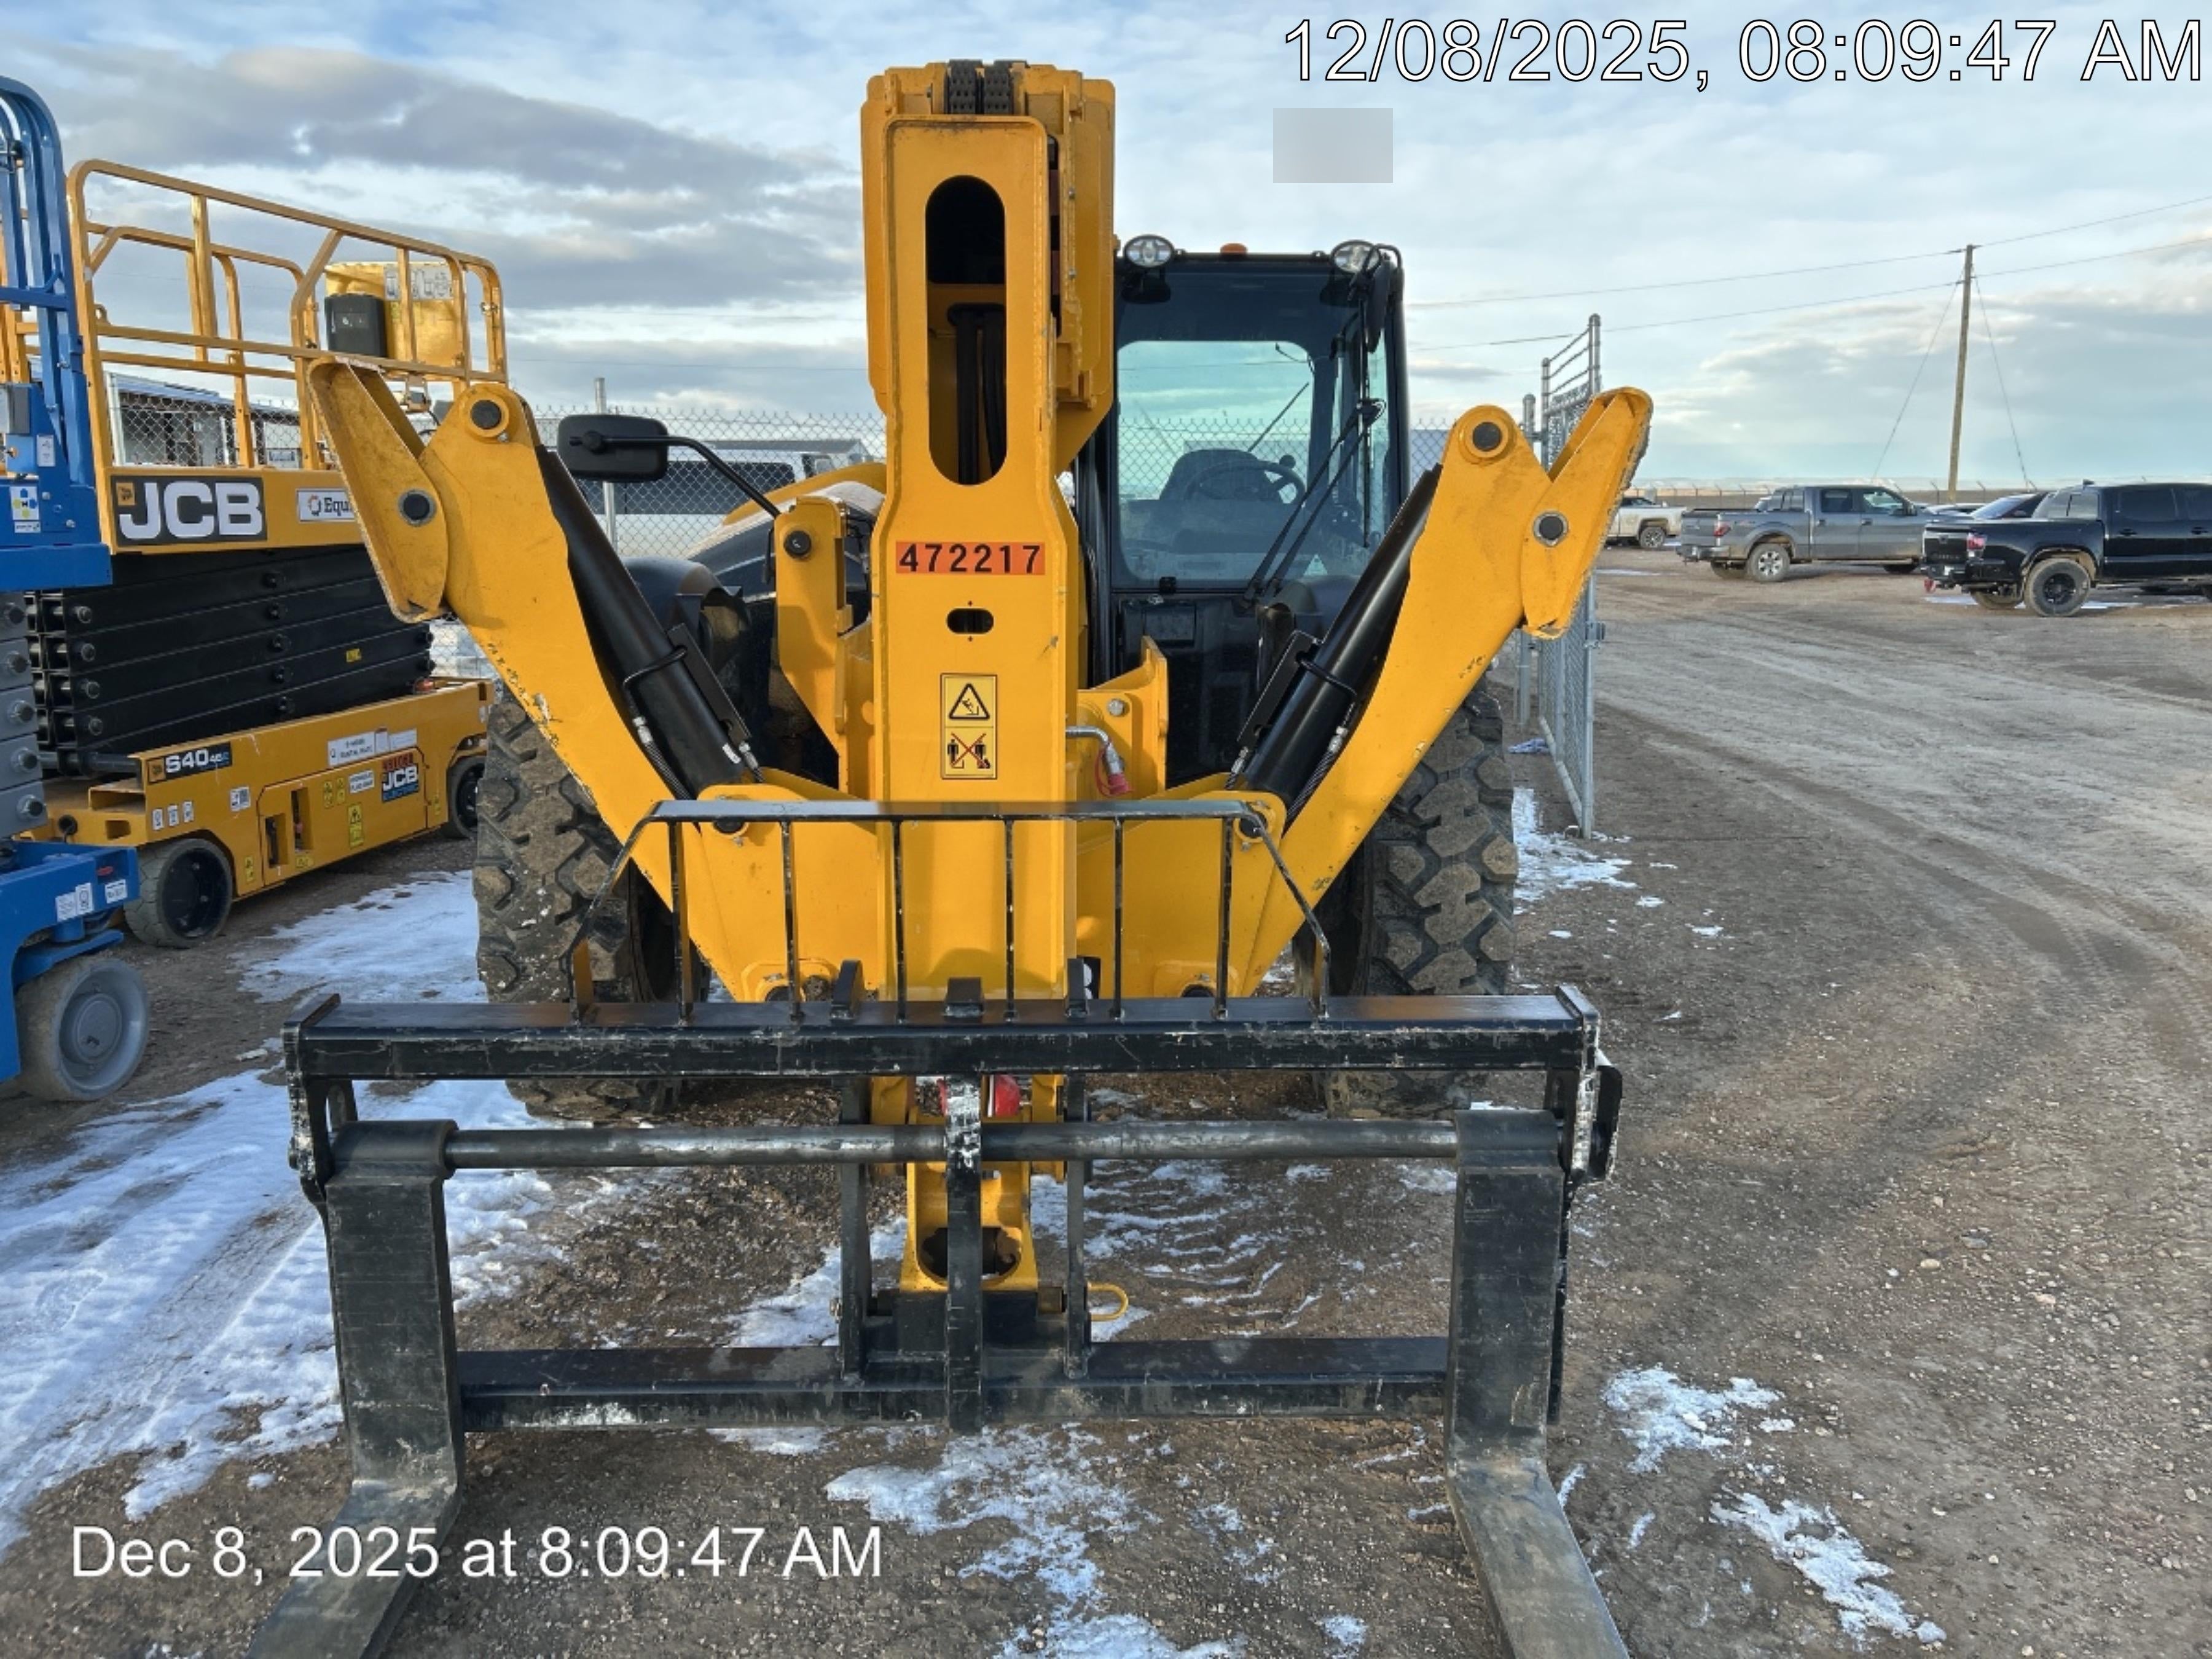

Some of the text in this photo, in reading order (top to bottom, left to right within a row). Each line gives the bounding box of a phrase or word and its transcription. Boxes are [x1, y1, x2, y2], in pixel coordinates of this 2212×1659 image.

[119, 481, 263, 539] JCB
[324, 496, 353, 517] Equ
[899, 543, 1040, 574] 472217
[383, 765, 418, 791] JCB
